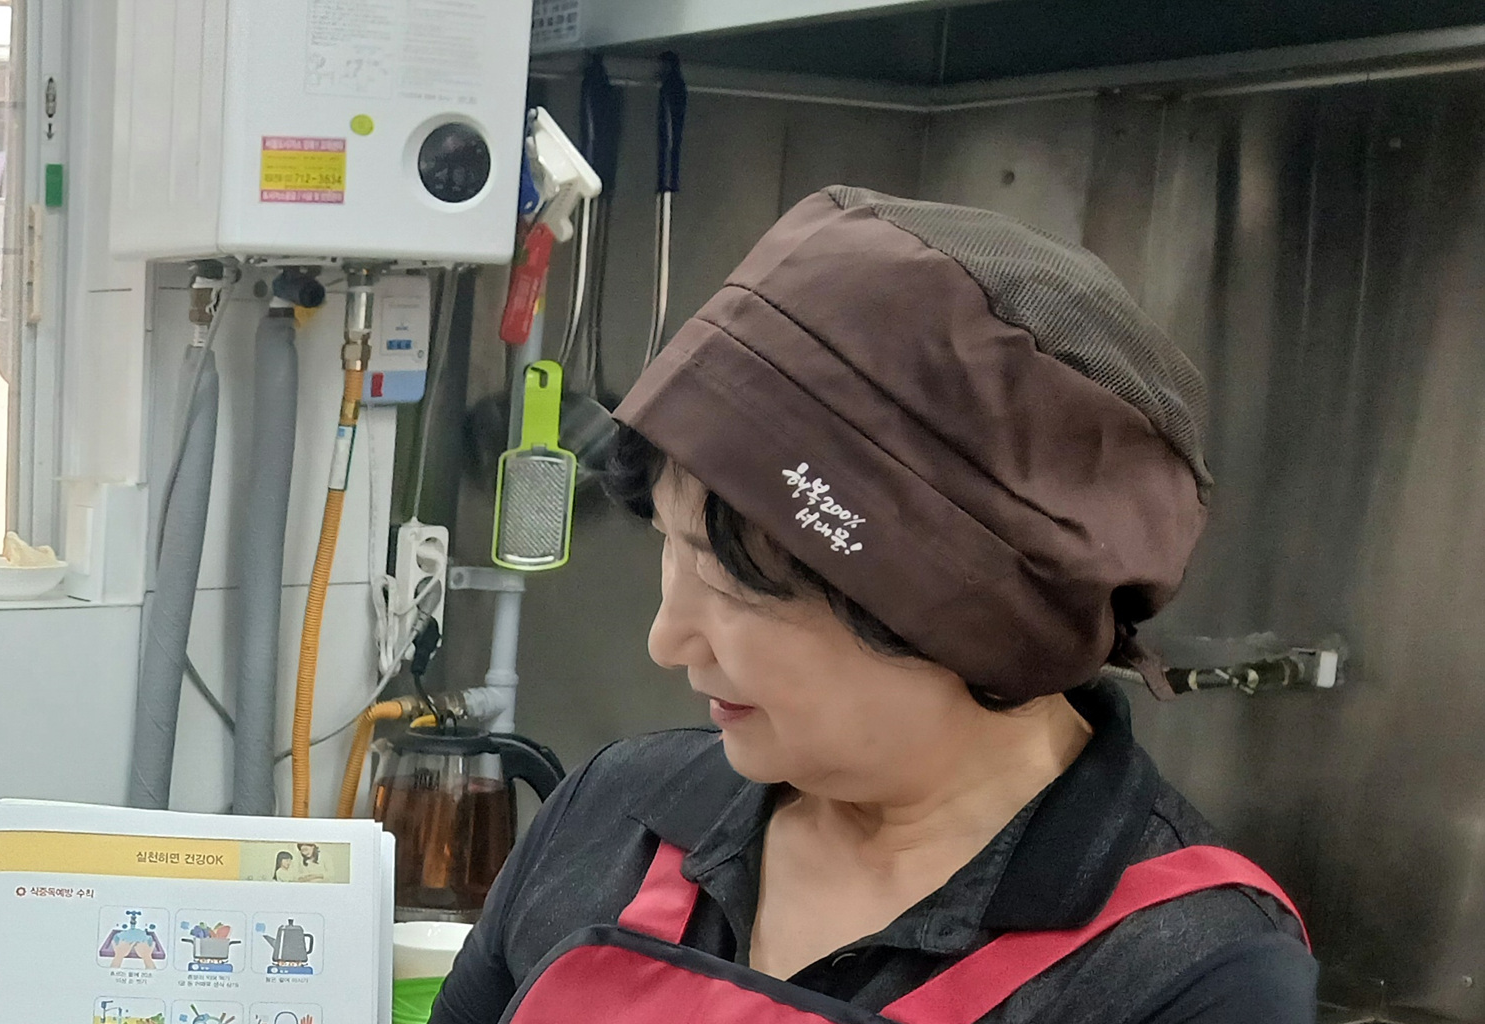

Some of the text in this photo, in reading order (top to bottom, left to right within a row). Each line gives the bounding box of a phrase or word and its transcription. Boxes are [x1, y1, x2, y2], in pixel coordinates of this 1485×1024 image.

[781, 461, 866, 529] 행복200%
[794, 507, 863, 555] 서대문!
[135, 851, 224, 866] 실천하면 건강OK
[30, 886, 74, 898] 식중독예방
